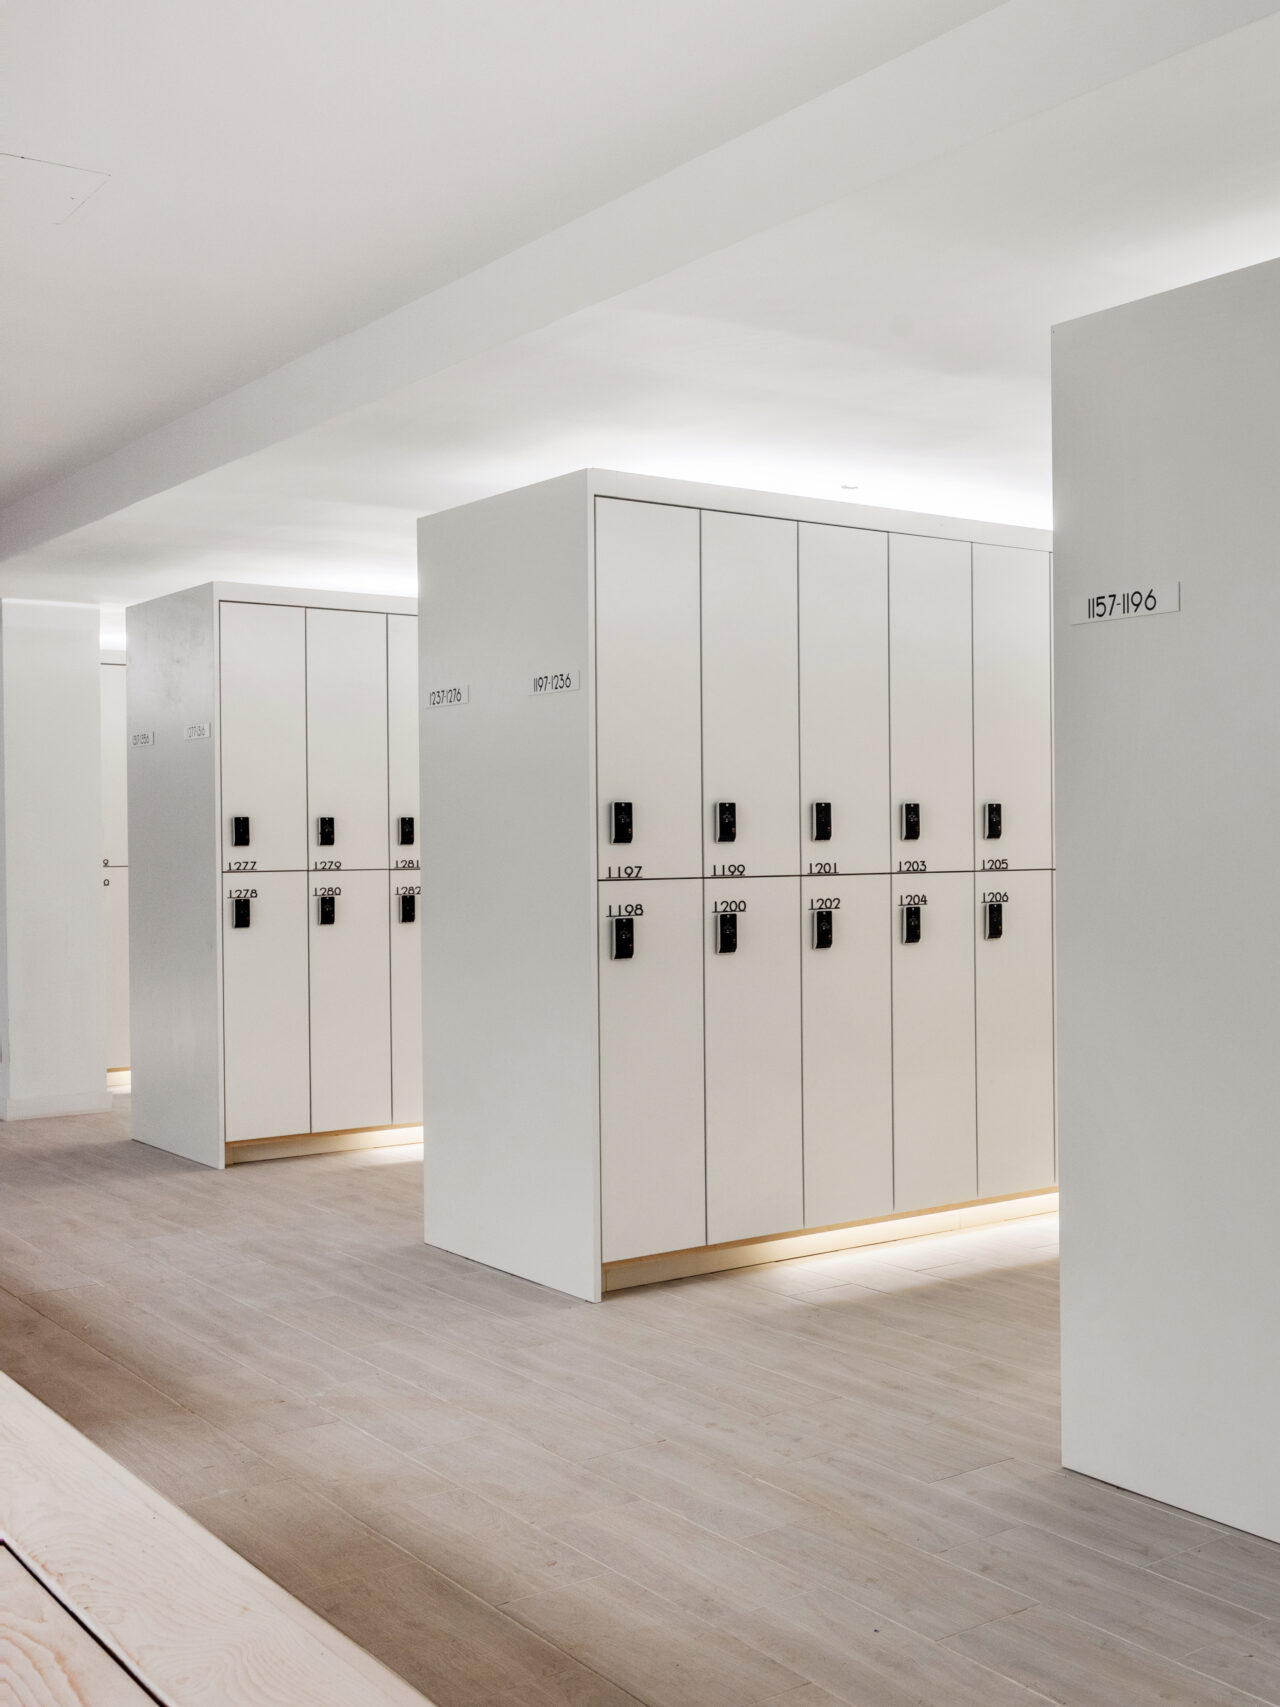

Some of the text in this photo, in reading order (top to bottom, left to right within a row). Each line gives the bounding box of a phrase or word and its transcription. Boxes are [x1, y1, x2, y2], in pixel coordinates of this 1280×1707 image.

[1088, 589, 1157, 619] 1157-1196
[534, 673, 571, 692] 1197-1236
[430, 689, 461, 705] 1237-1276
[227, 861, 257, 871] 1277
[313, 861, 341, 870] 1279
[394, 860, 420, 868] 1281
[711, 864, 745, 876] 1199
[808, 862, 838, 874] 1201
[898, 860, 926, 872] 1203
[981, 859, 1008, 870] 1205
[606, 866, 642, 878] 1197
[228, 889, 258, 898] 1278
[313, 887, 341, 896] 1280
[395, 887, 421, 895] 1282
[898, 895, 927, 906] 1204
[981, 892, 1008, 903] 1206
[606, 904, 643, 916] 1198
[713, 900, 746, 912] 1200
[809, 898, 840, 910] 1202
